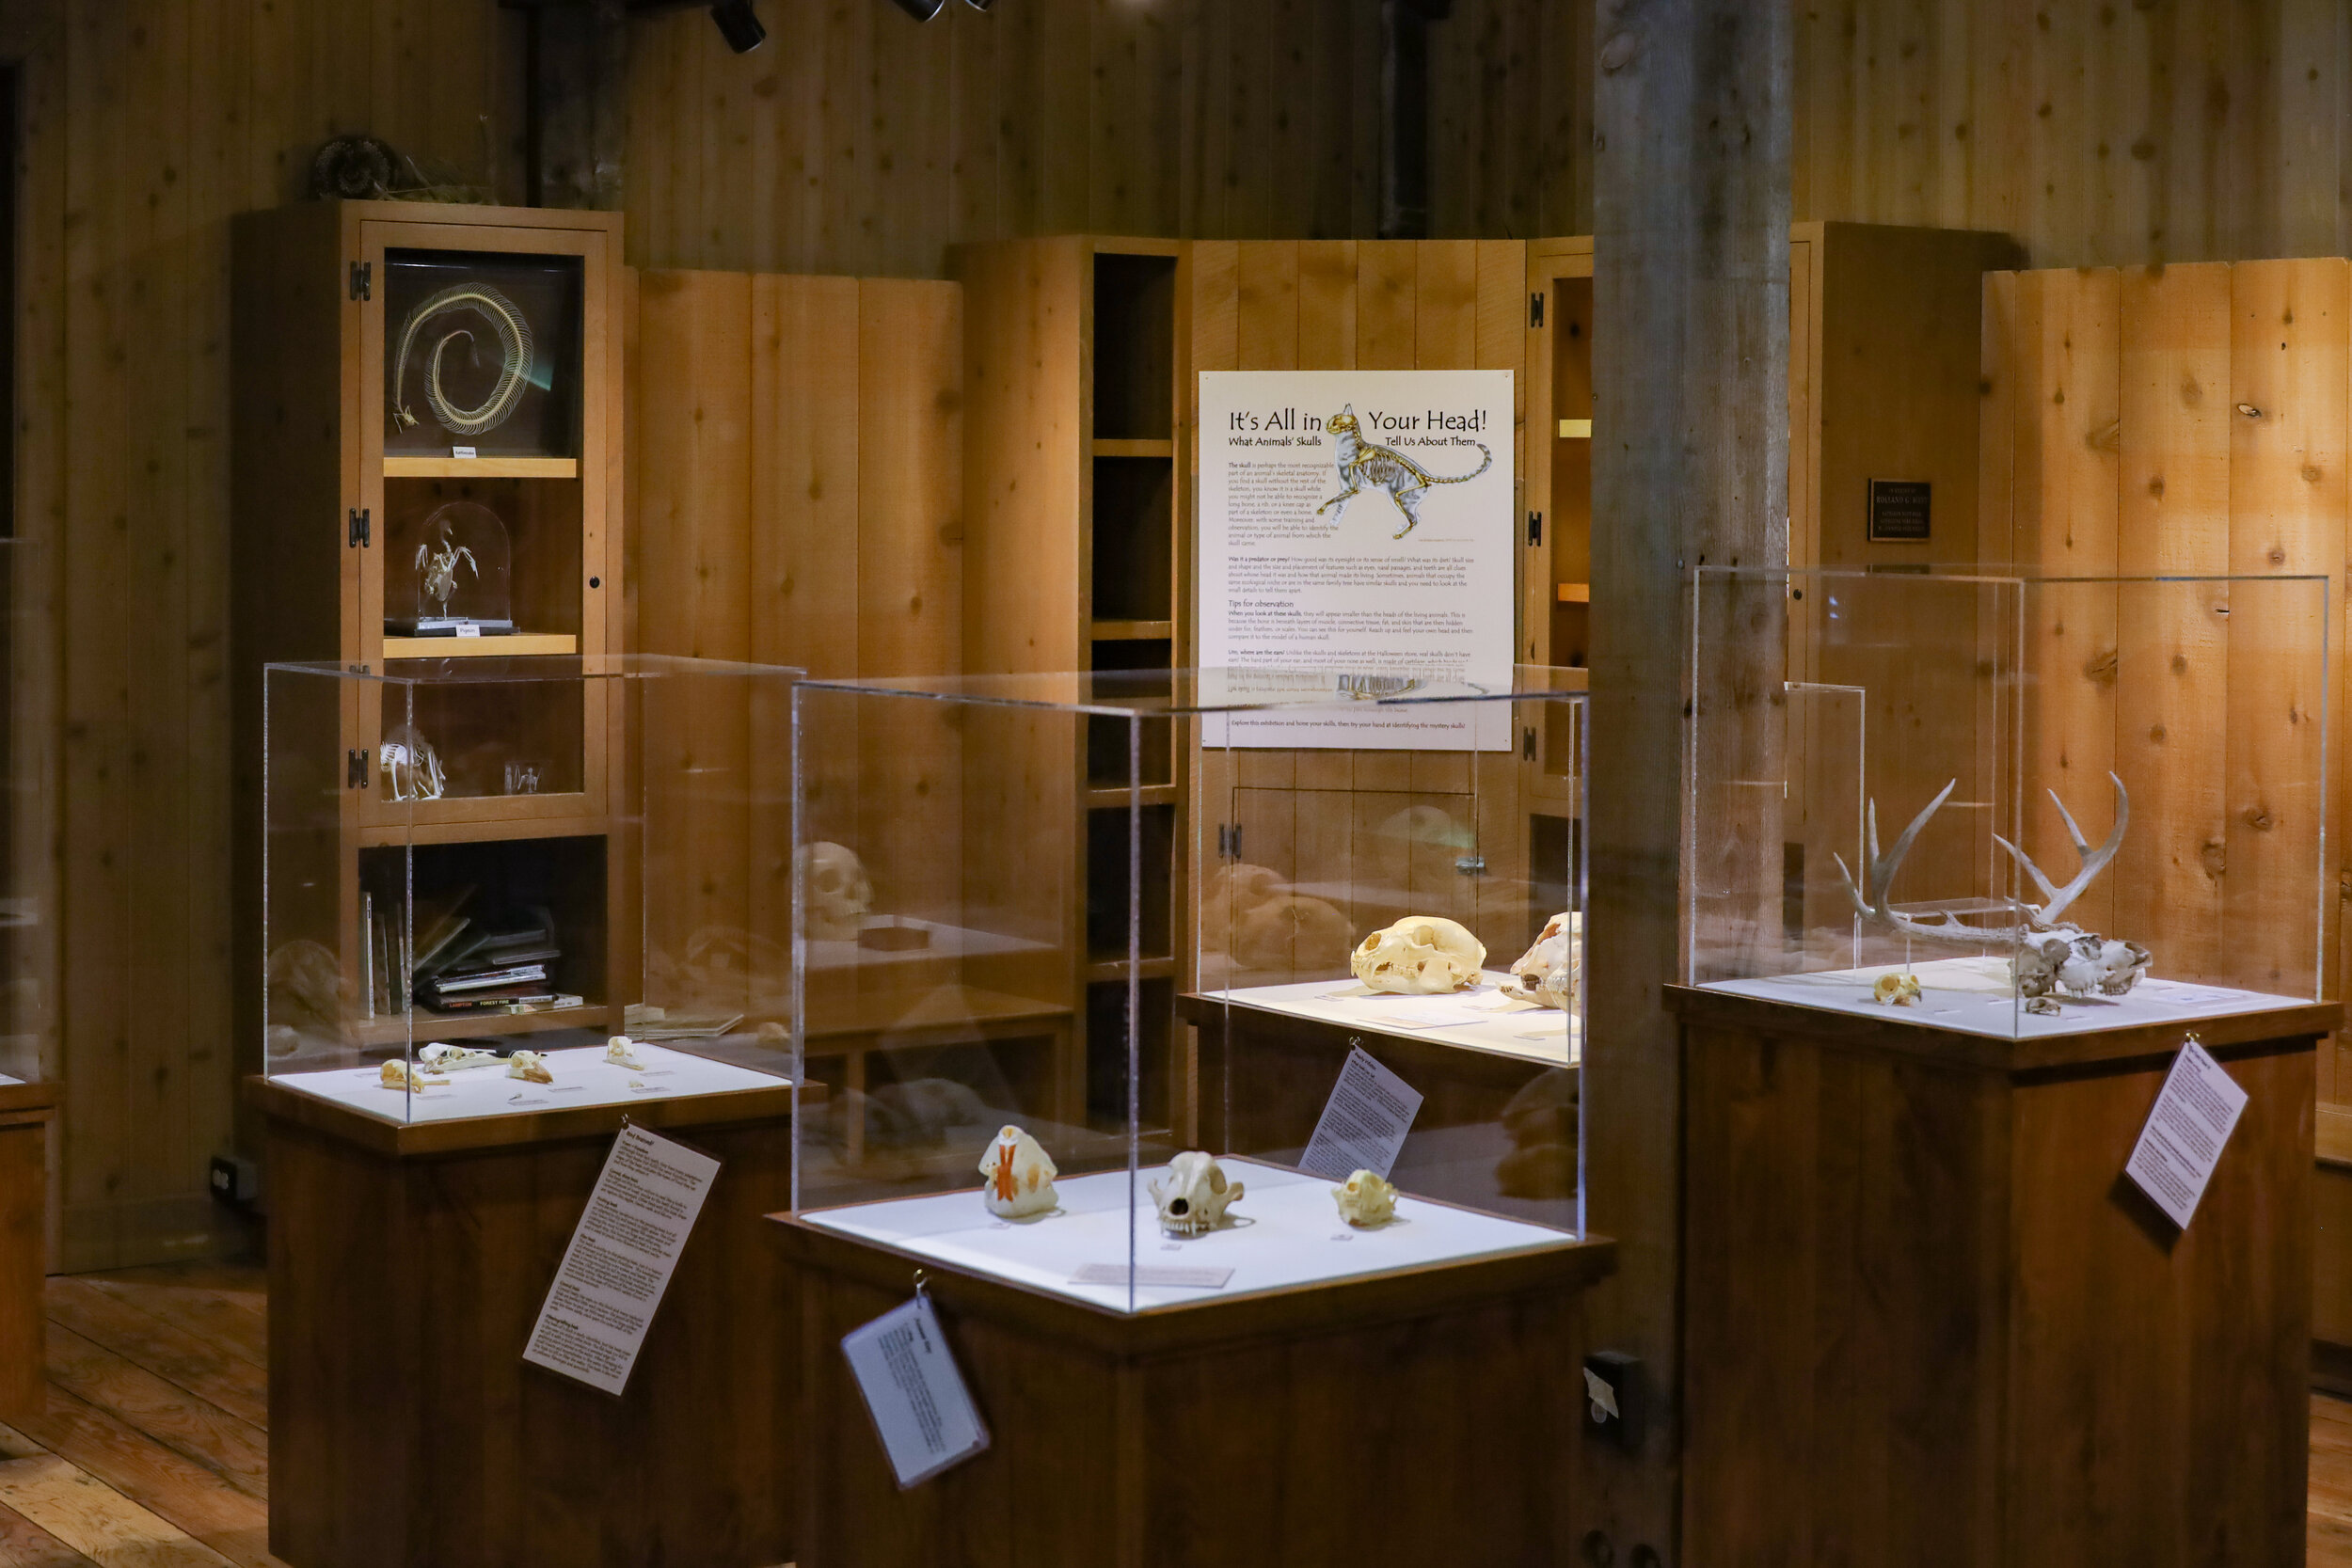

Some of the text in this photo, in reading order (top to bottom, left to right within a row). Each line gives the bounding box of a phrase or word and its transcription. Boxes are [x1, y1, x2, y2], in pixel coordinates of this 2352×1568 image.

[1230, 408, 1486, 431] It's All in Your Head!
[1228, 436, 1476, 446] What Animals' Skulls Tell Us About Them
[1228, 599, 1294, 609] Tips for observation
